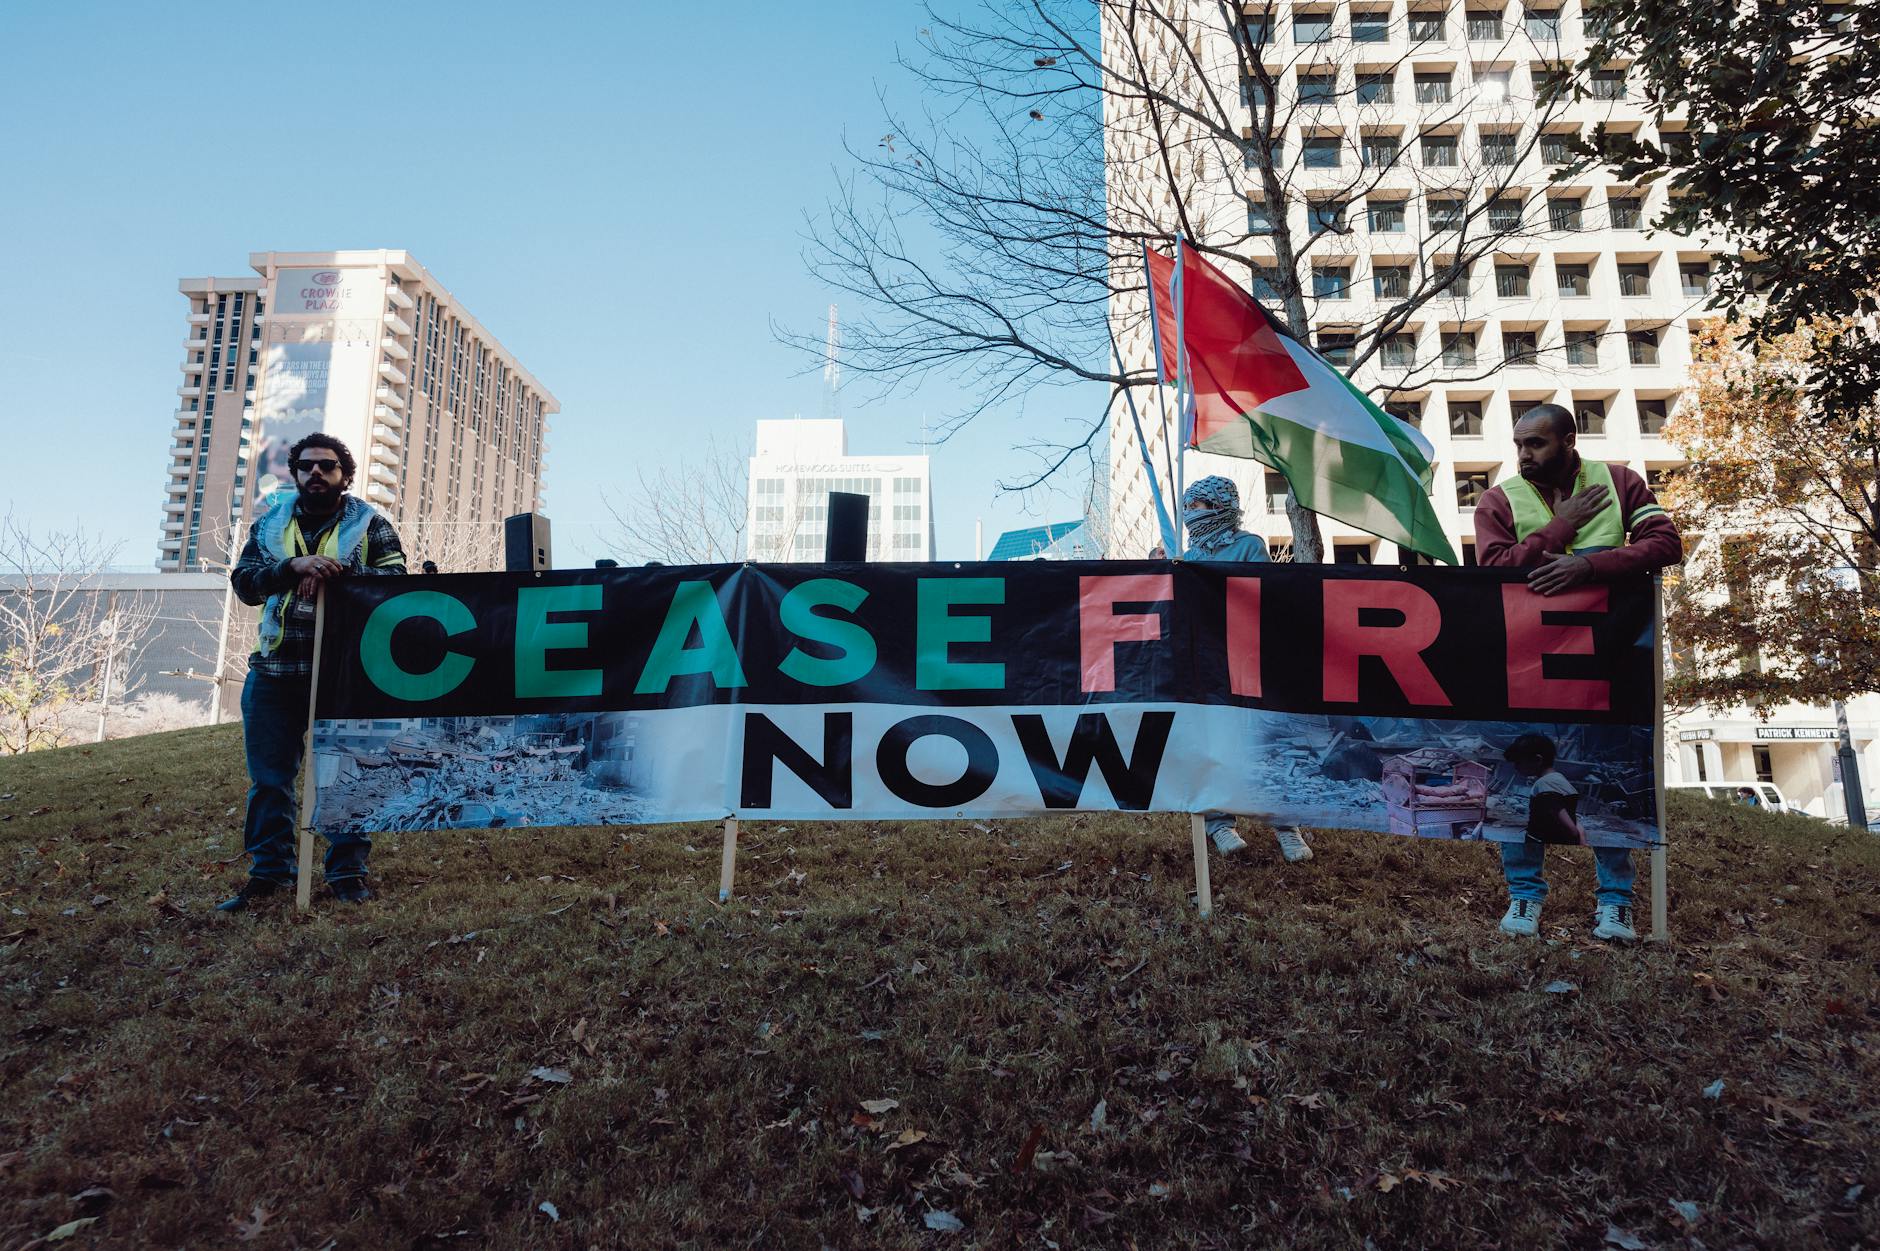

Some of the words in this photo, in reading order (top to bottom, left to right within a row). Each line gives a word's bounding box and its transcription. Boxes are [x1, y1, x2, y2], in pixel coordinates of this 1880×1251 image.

[300, 287, 352, 299] CROWNE
[304, 299, 344, 310] PLAZA
[775, 464, 837, 473] HOMEWOOD
[839, 463, 872, 473] SUITES
[1680, 731, 1697, 741] IRISH
[1697, 729, 1710, 740] PUB
[1758, 728, 1793, 738] PATRICK
[1794, 728, 1839, 738] KENNEDY'S
[740, 711, 1176, 811] NOW
